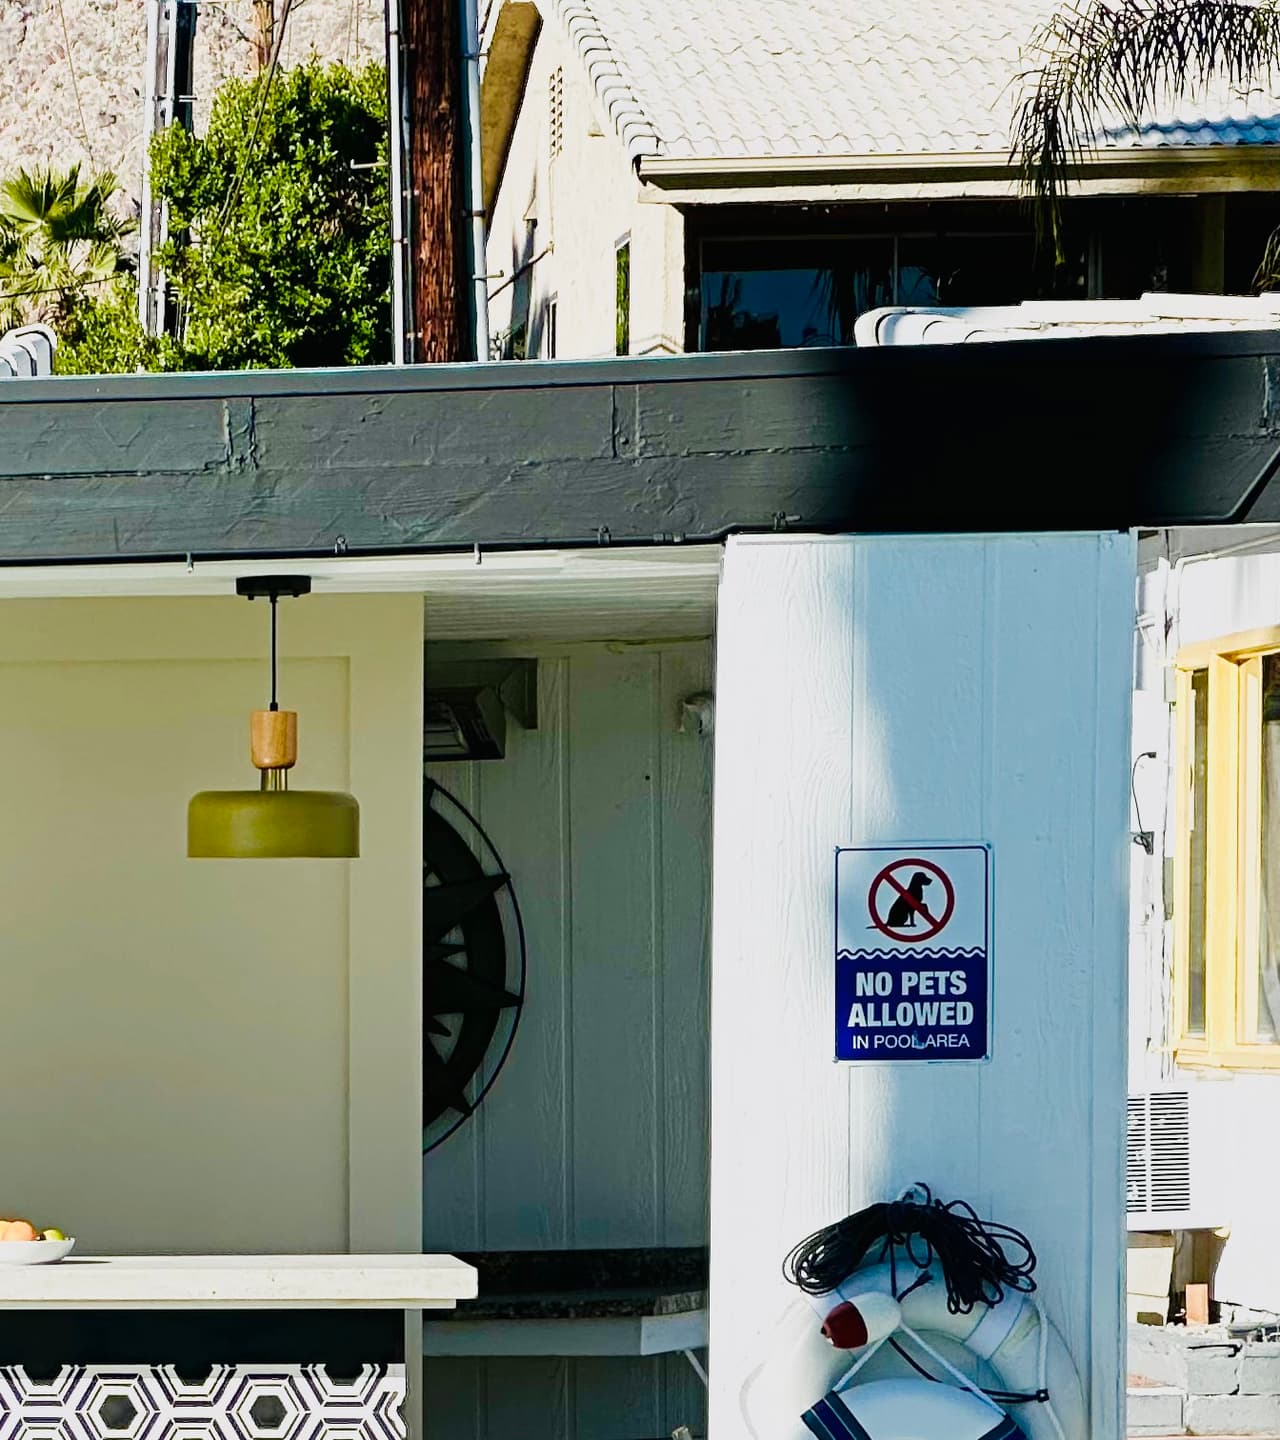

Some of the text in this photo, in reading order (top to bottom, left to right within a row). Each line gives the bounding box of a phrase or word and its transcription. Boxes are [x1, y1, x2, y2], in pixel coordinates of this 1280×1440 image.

[856, 970, 967, 996] NO PETS
[847, 1001, 974, 1027] ALLOWED
[852, 1035, 869, 1049] IN
[926, 1034, 970, 1048] AREA
